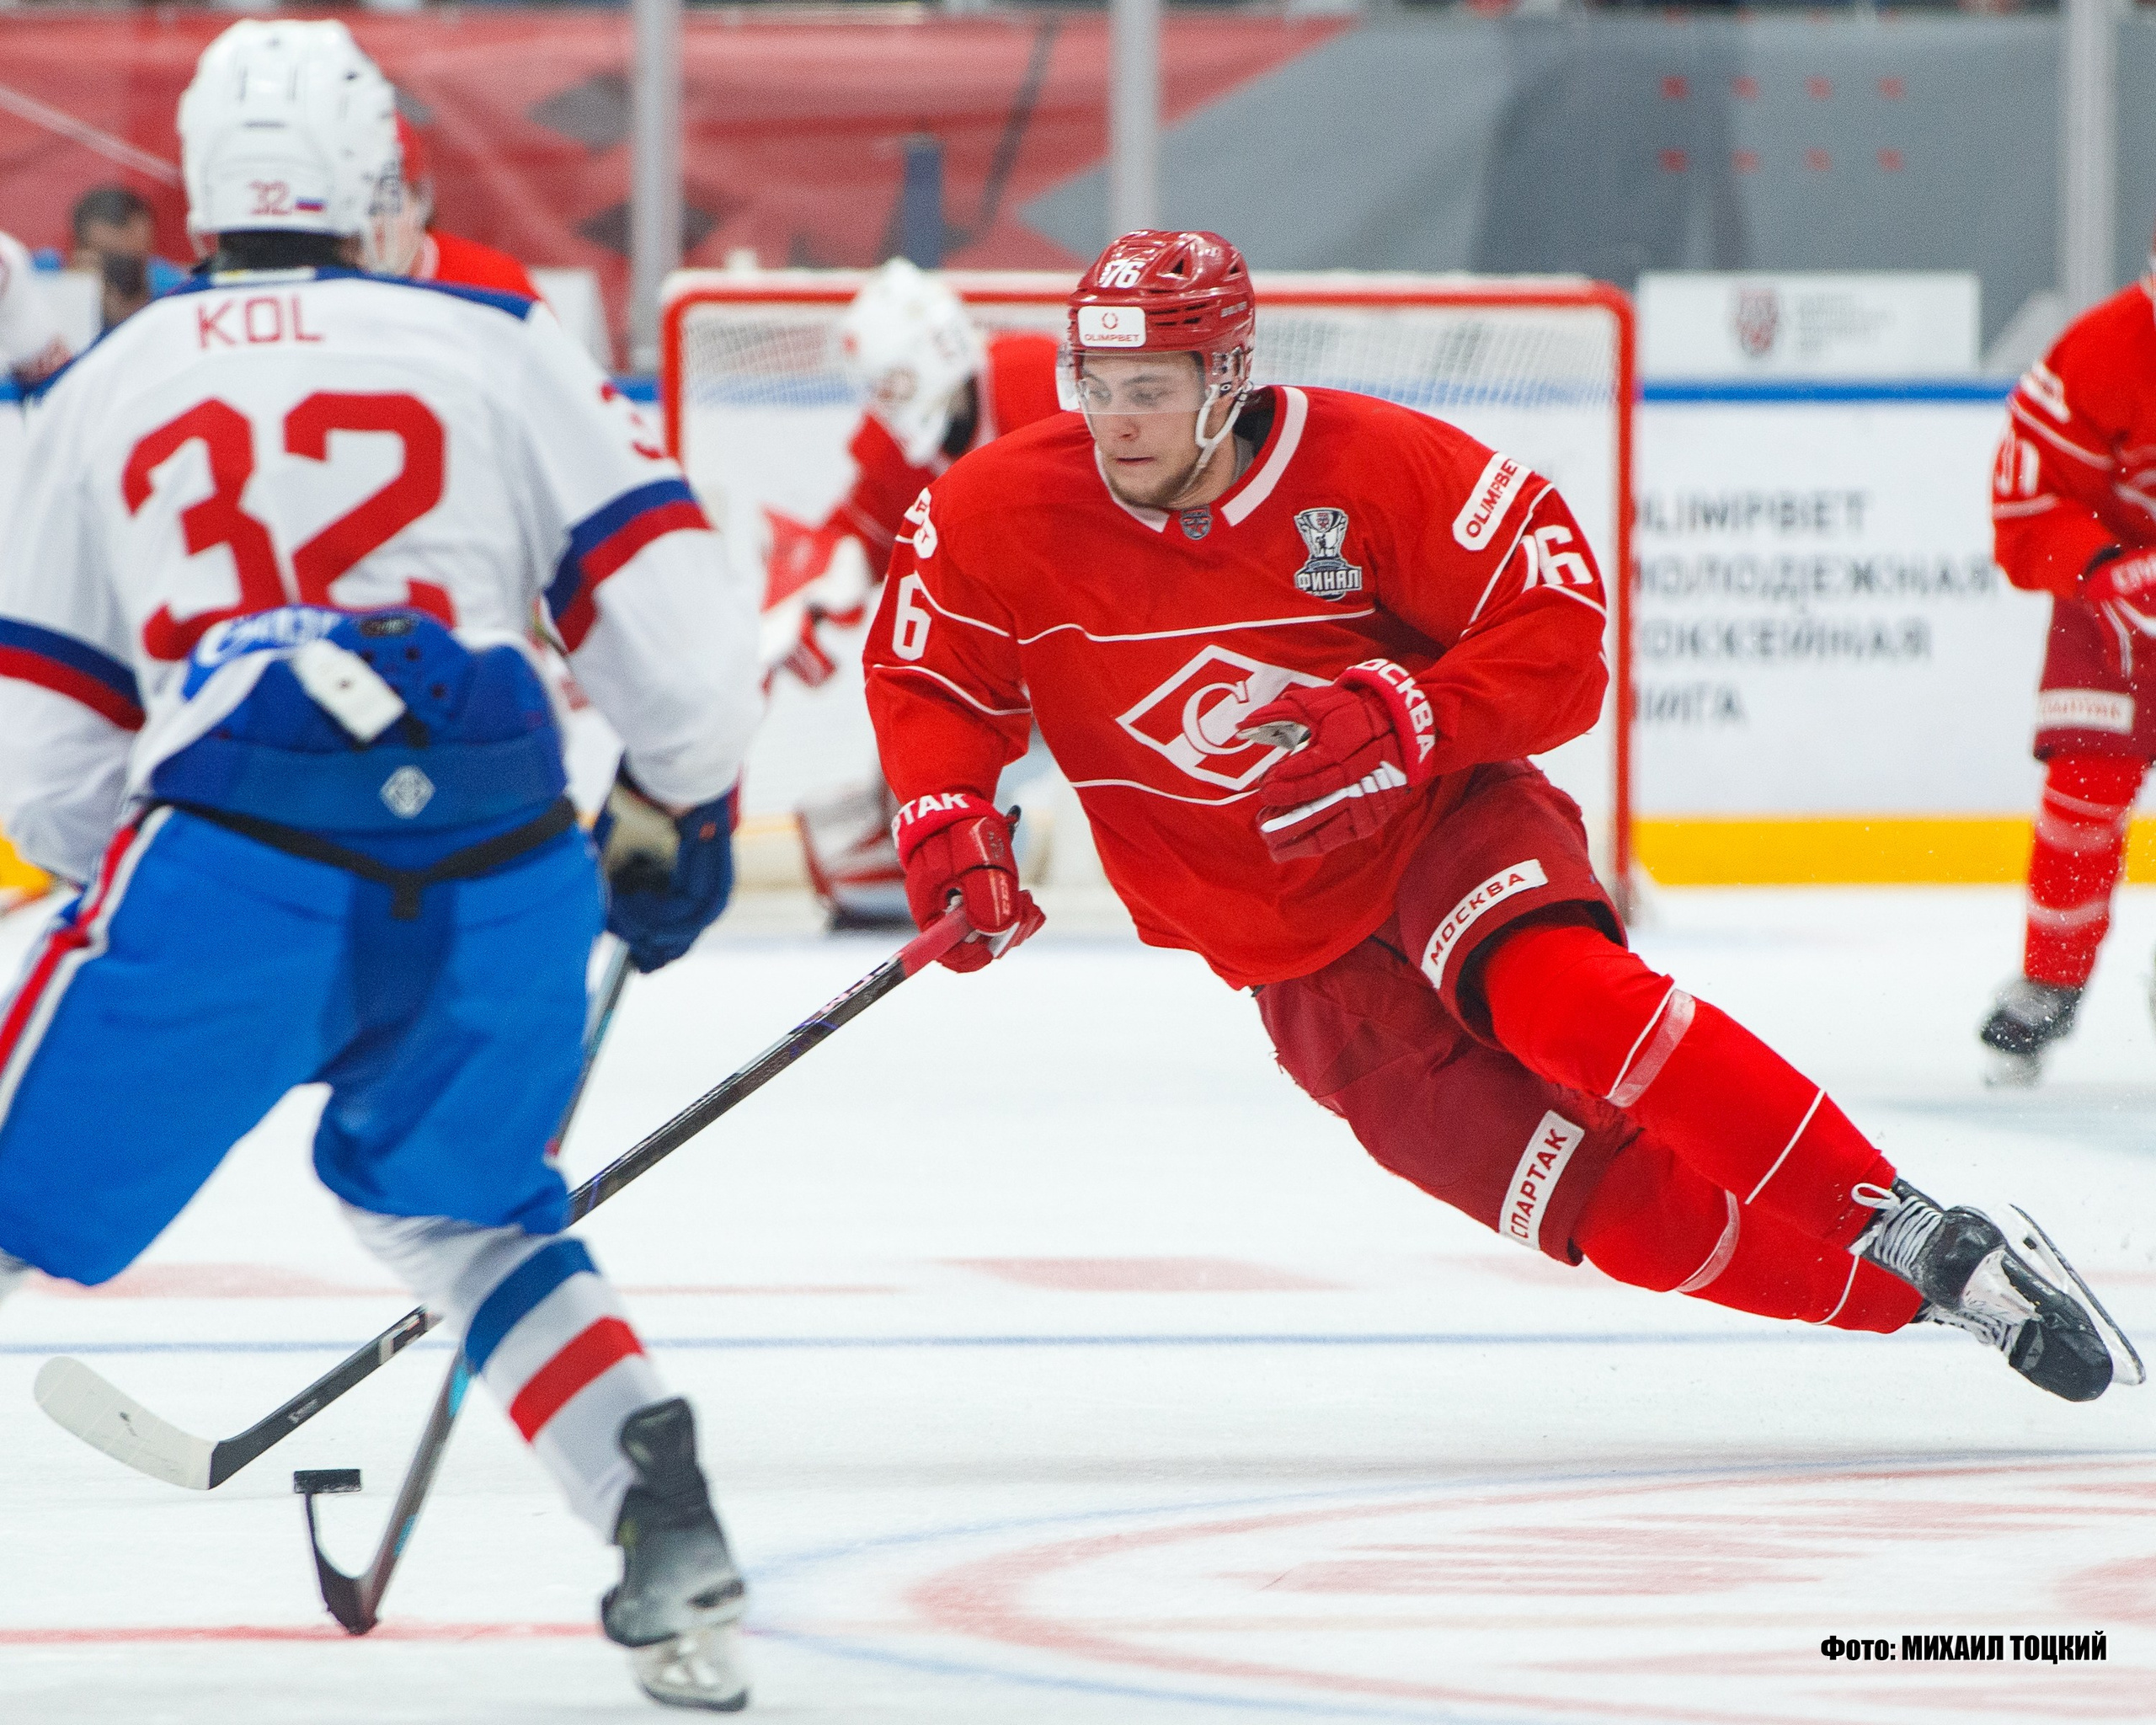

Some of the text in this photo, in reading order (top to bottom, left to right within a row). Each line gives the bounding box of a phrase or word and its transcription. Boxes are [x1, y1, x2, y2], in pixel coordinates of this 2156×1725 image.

[248, 179, 292, 216] 32
[1100, 259, 1146, 288] 76
[197, 292, 325, 350] KOL
[1085, 334, 1139, 342] OLIMPBET
[1465, 458, 1518, 538] OLIMPBE
[1638, 489, 1866, 535] LIMPBET
[121, 392, 456, 661] 32
[1298, 570, 1359, 590] ФИНАЛ
[1638, 604, 1932, 657] ОККЕЙНАЯ
[891, 793, 970, 846] ТАК
[1430, 873, 1526, 965] МОСКВА
[1510, 1129, 1568, 1239] СПАРТАК
